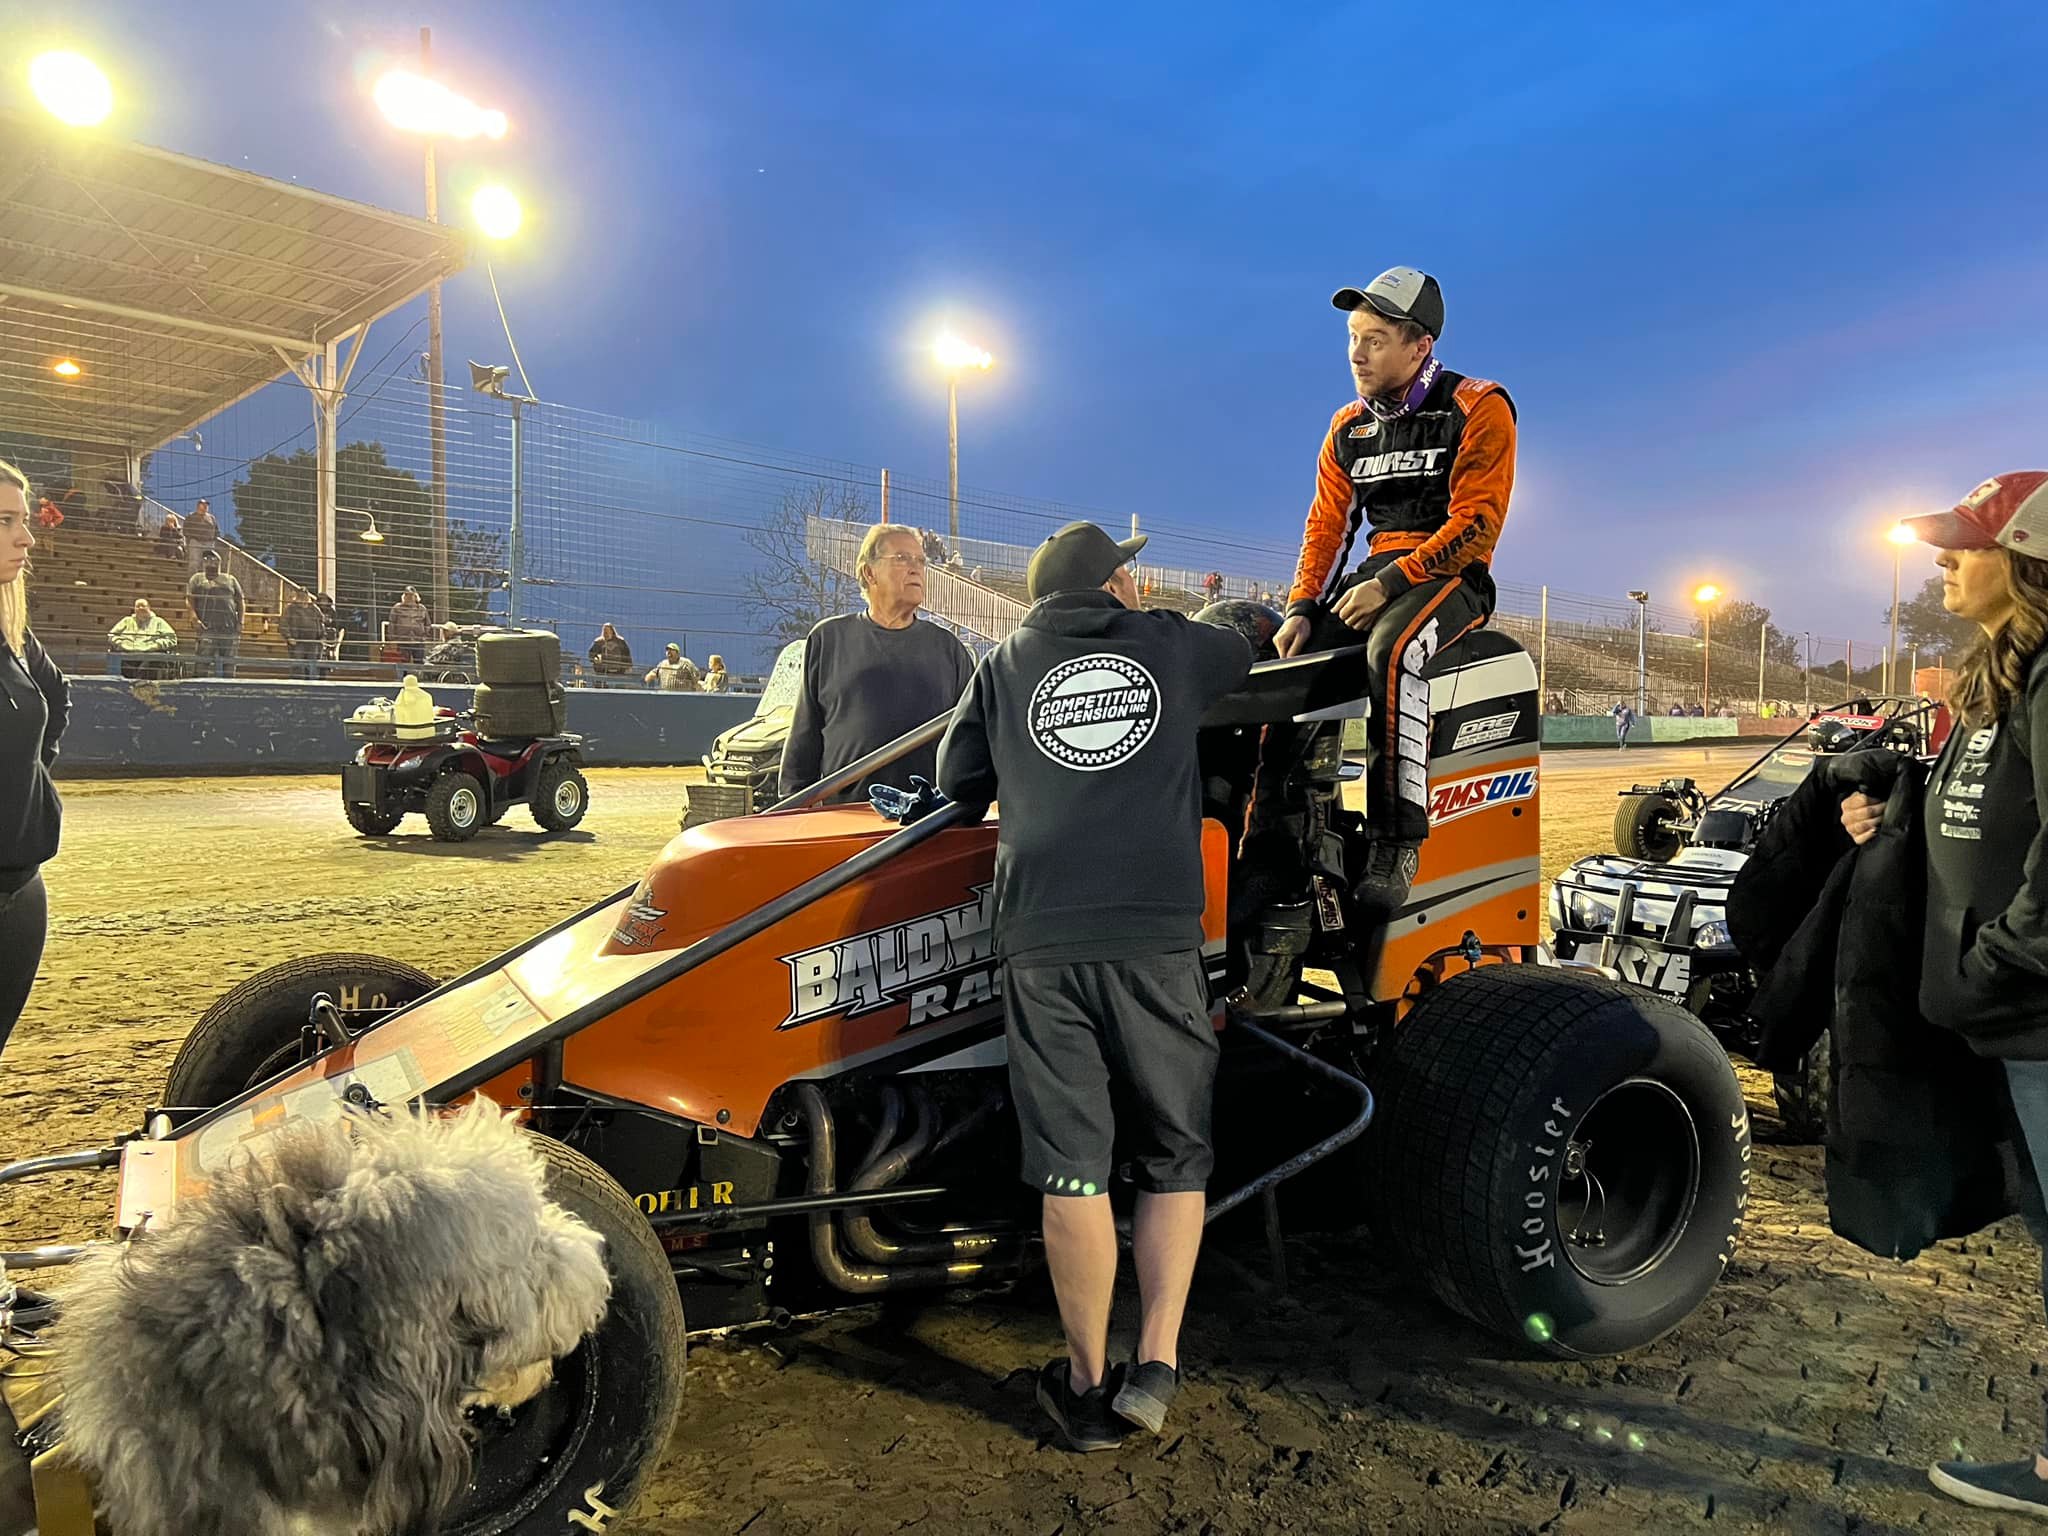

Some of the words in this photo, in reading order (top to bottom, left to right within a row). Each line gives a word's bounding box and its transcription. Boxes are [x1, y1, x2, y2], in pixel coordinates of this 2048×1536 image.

[1419, 358, 1440, 389] Hoos
[1036, 706, 1128, 731] SUSPENSION
[1129, 703, 1148, 713] INC
[1039, 688, 1151, 717] COMPETITION
[1427, 771, 1533, 820] AMSOIL
[792, 886, 995, 1018] BALDW
[1514, 1096, 1573, 1273] Hoosier
